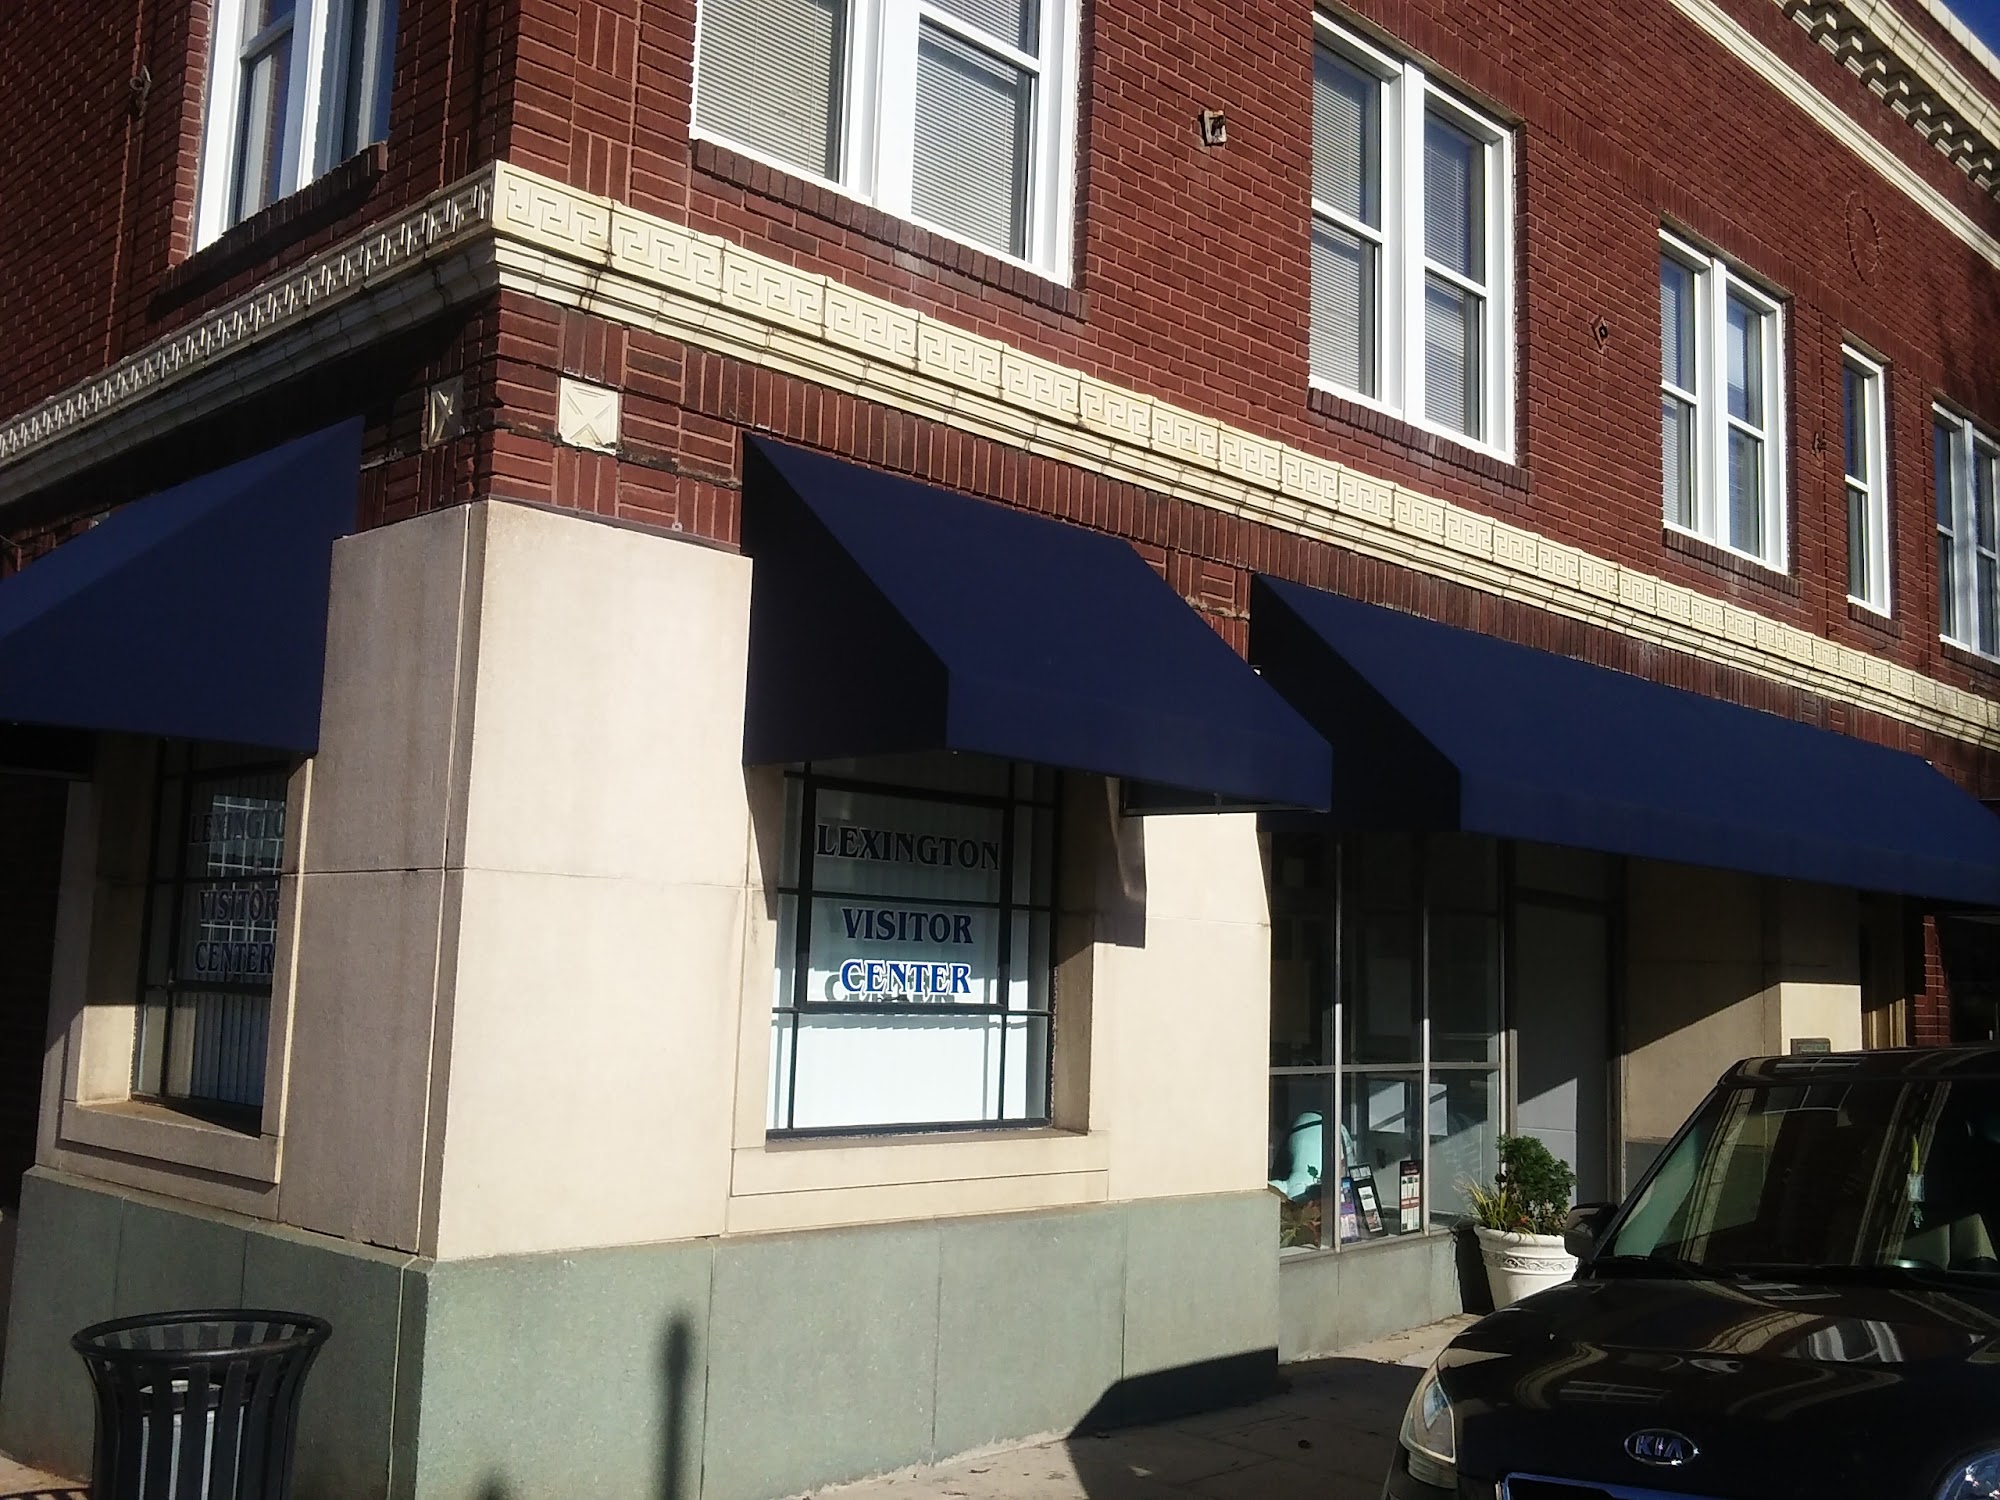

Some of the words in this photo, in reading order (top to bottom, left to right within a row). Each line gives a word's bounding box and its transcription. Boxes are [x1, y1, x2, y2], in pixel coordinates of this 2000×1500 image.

[190, 810, 285, 842] LEXINGTO
[815, 824, 1000, 871] LEXINGTON
[200, 889, 279, 921] VISITOR
[842, 907, 973, 945] VISITOR
[194, 940, 274, 974] CENTER
[840, 960, 972, 995] CENTER
[1635, 1435, 1684, 1460] KIA
